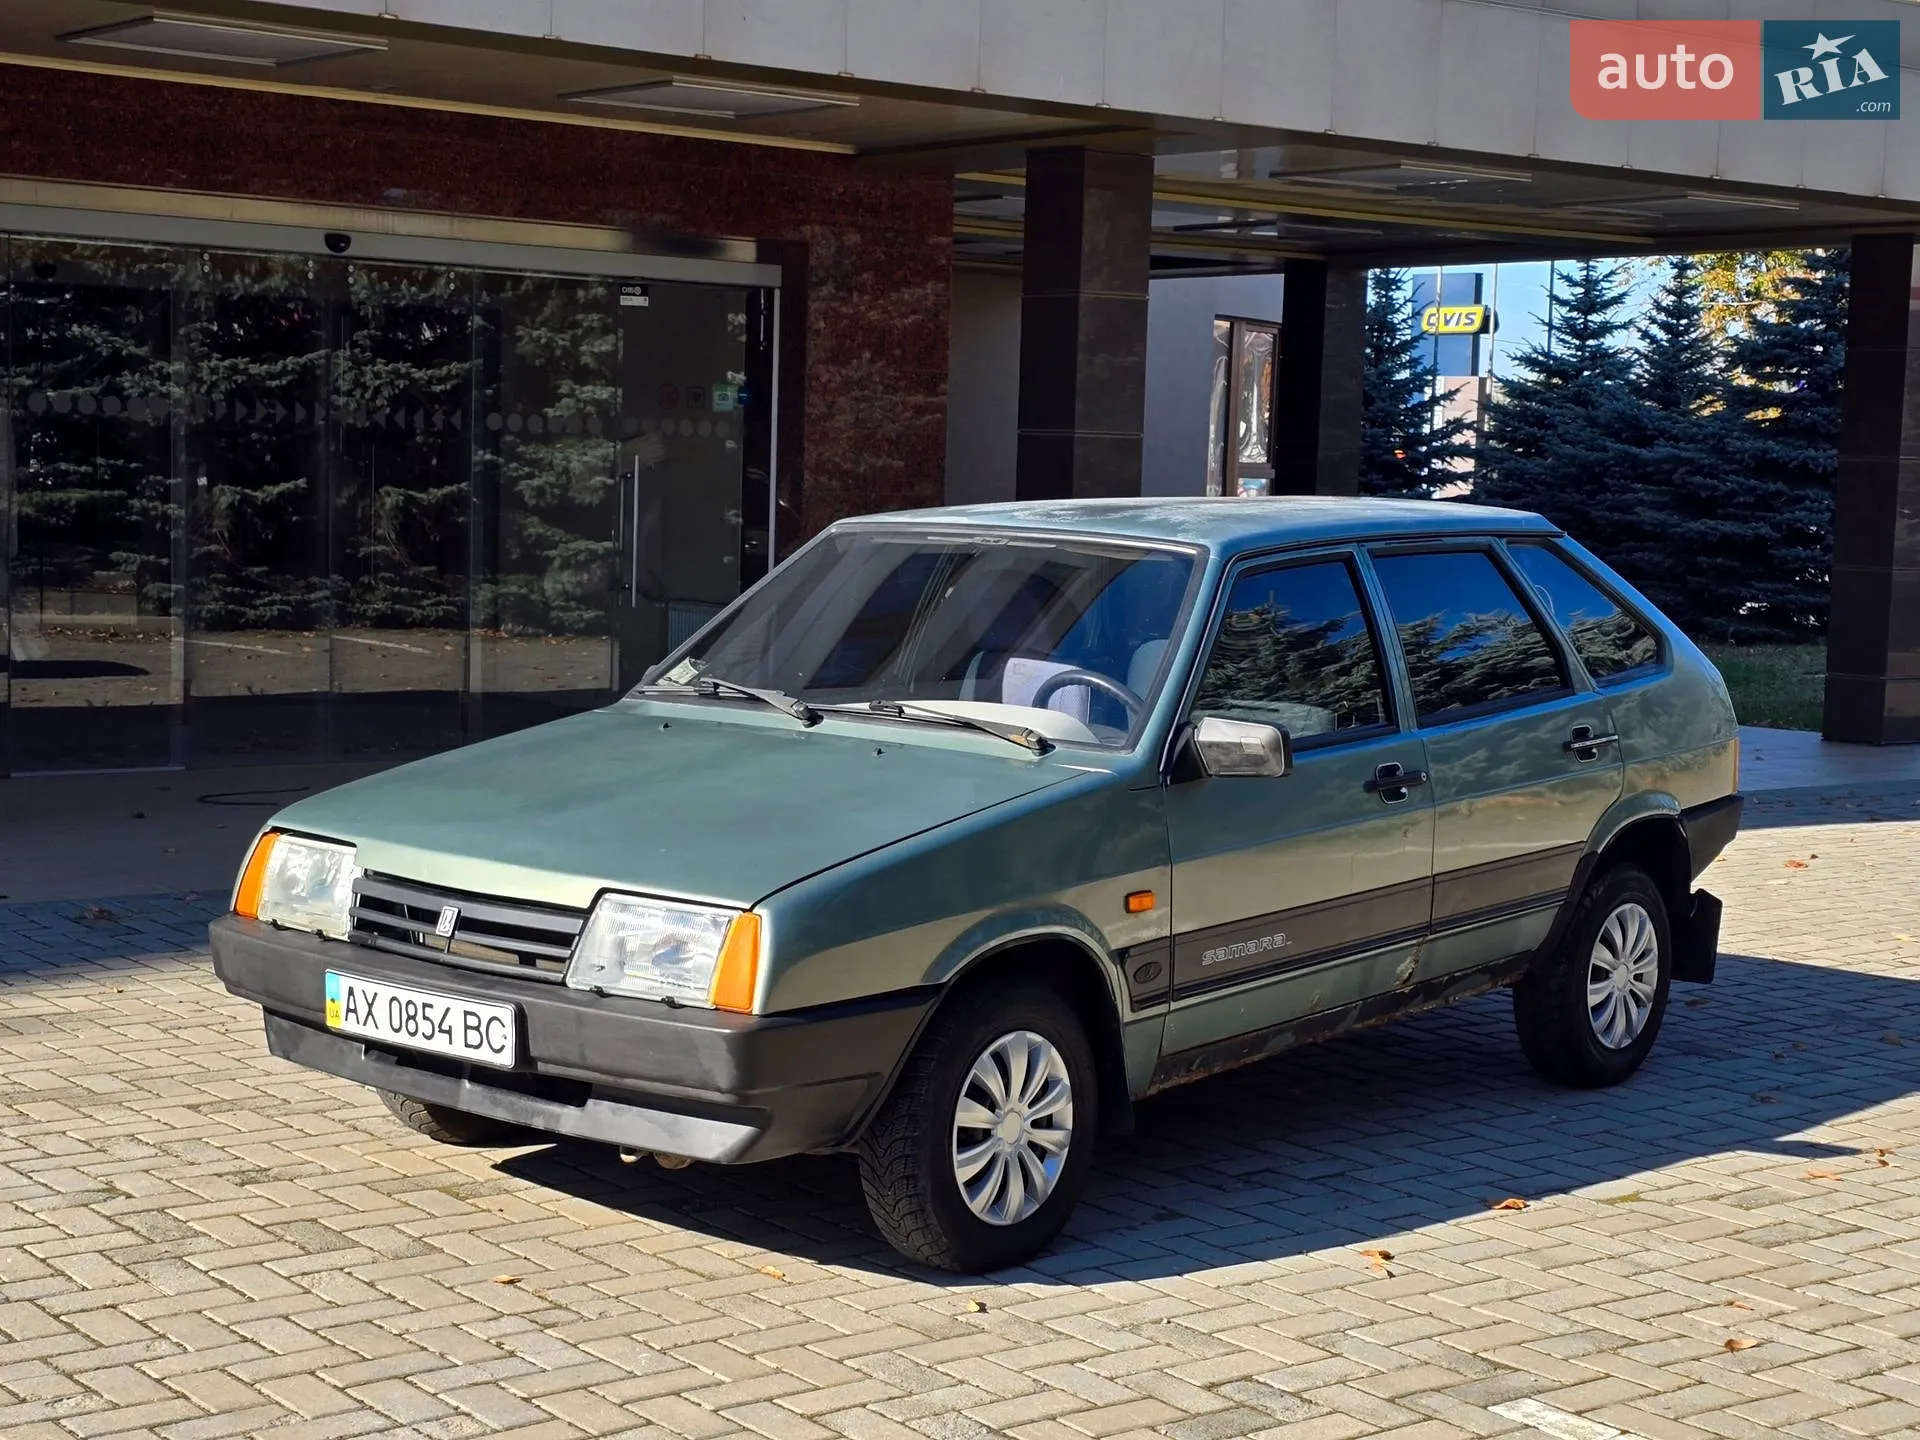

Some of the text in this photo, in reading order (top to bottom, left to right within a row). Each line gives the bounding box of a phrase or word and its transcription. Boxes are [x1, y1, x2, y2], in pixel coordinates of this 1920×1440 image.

[329, 1007, 341, 1019] UA
[345, 986, 506, 1054] AX 0854 BC
